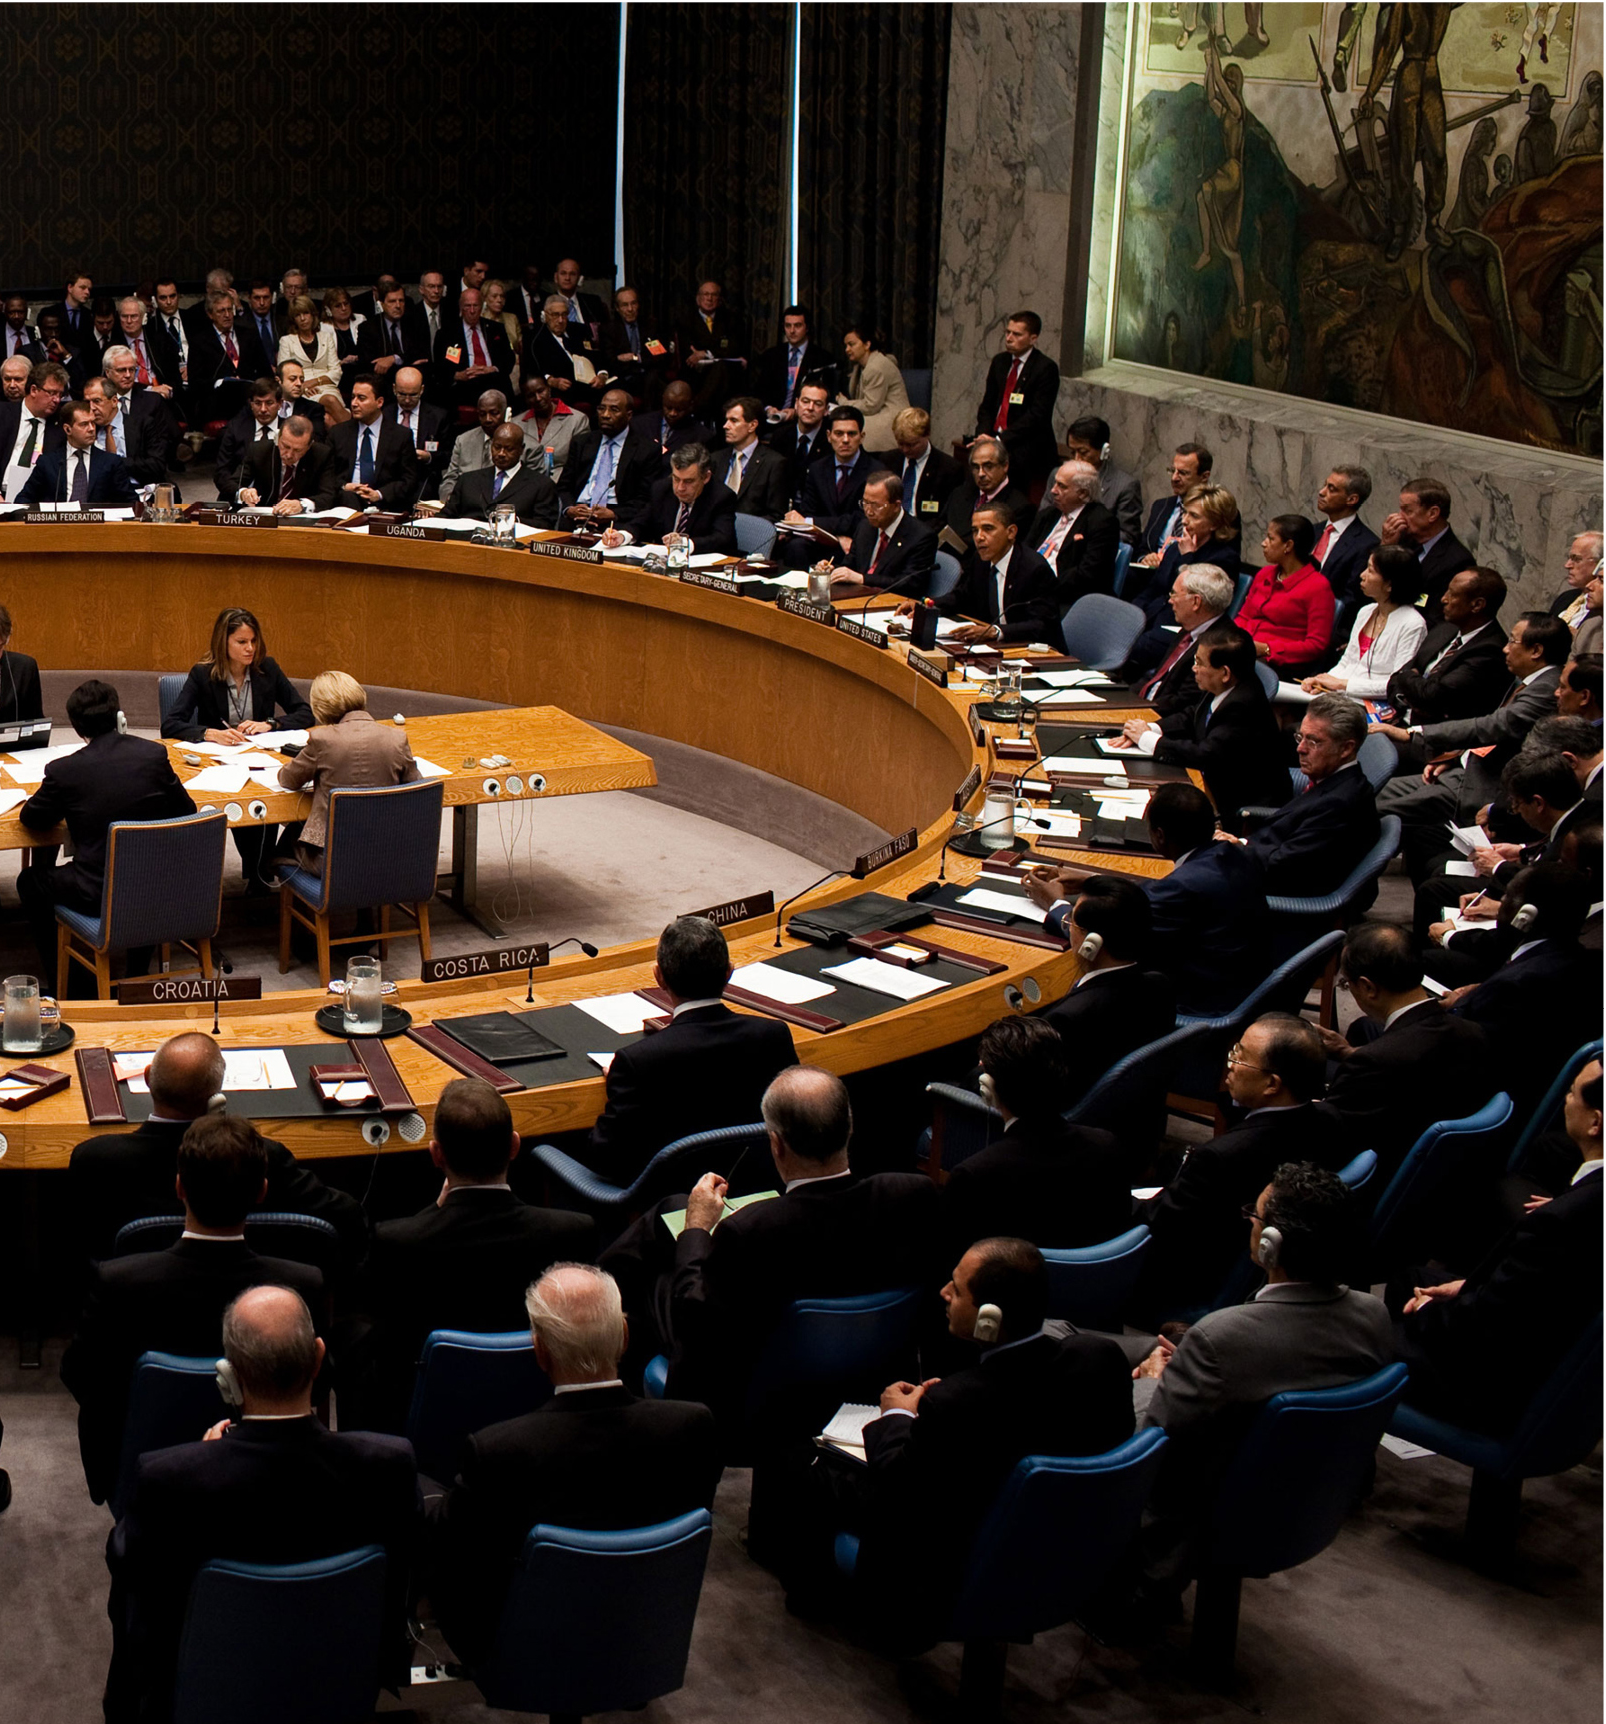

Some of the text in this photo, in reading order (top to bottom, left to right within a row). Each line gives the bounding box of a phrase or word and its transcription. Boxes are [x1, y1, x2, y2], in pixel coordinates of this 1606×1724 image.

[27, 513, 103, 522] RUSSIAN FEDERATION
[215, 513, 261, 526] TURKEY
[386, 525, 426, 538] UGANDA
[533, 542, 599, 561] UNITED KINGDOM
[682, 570, 738, 594] SECRETARY-GENERAL
[784, 598, 826, 622] PRESIDENT
[839, 619, 882, 644] UNITED STATES
[867, 834, 910, 870] BURKINA FASO
[707, 902, 748, 924] CHINA
[434, 947, 540, 978] COSTA RICA
[153, 980, 229, 999] CROATIA
